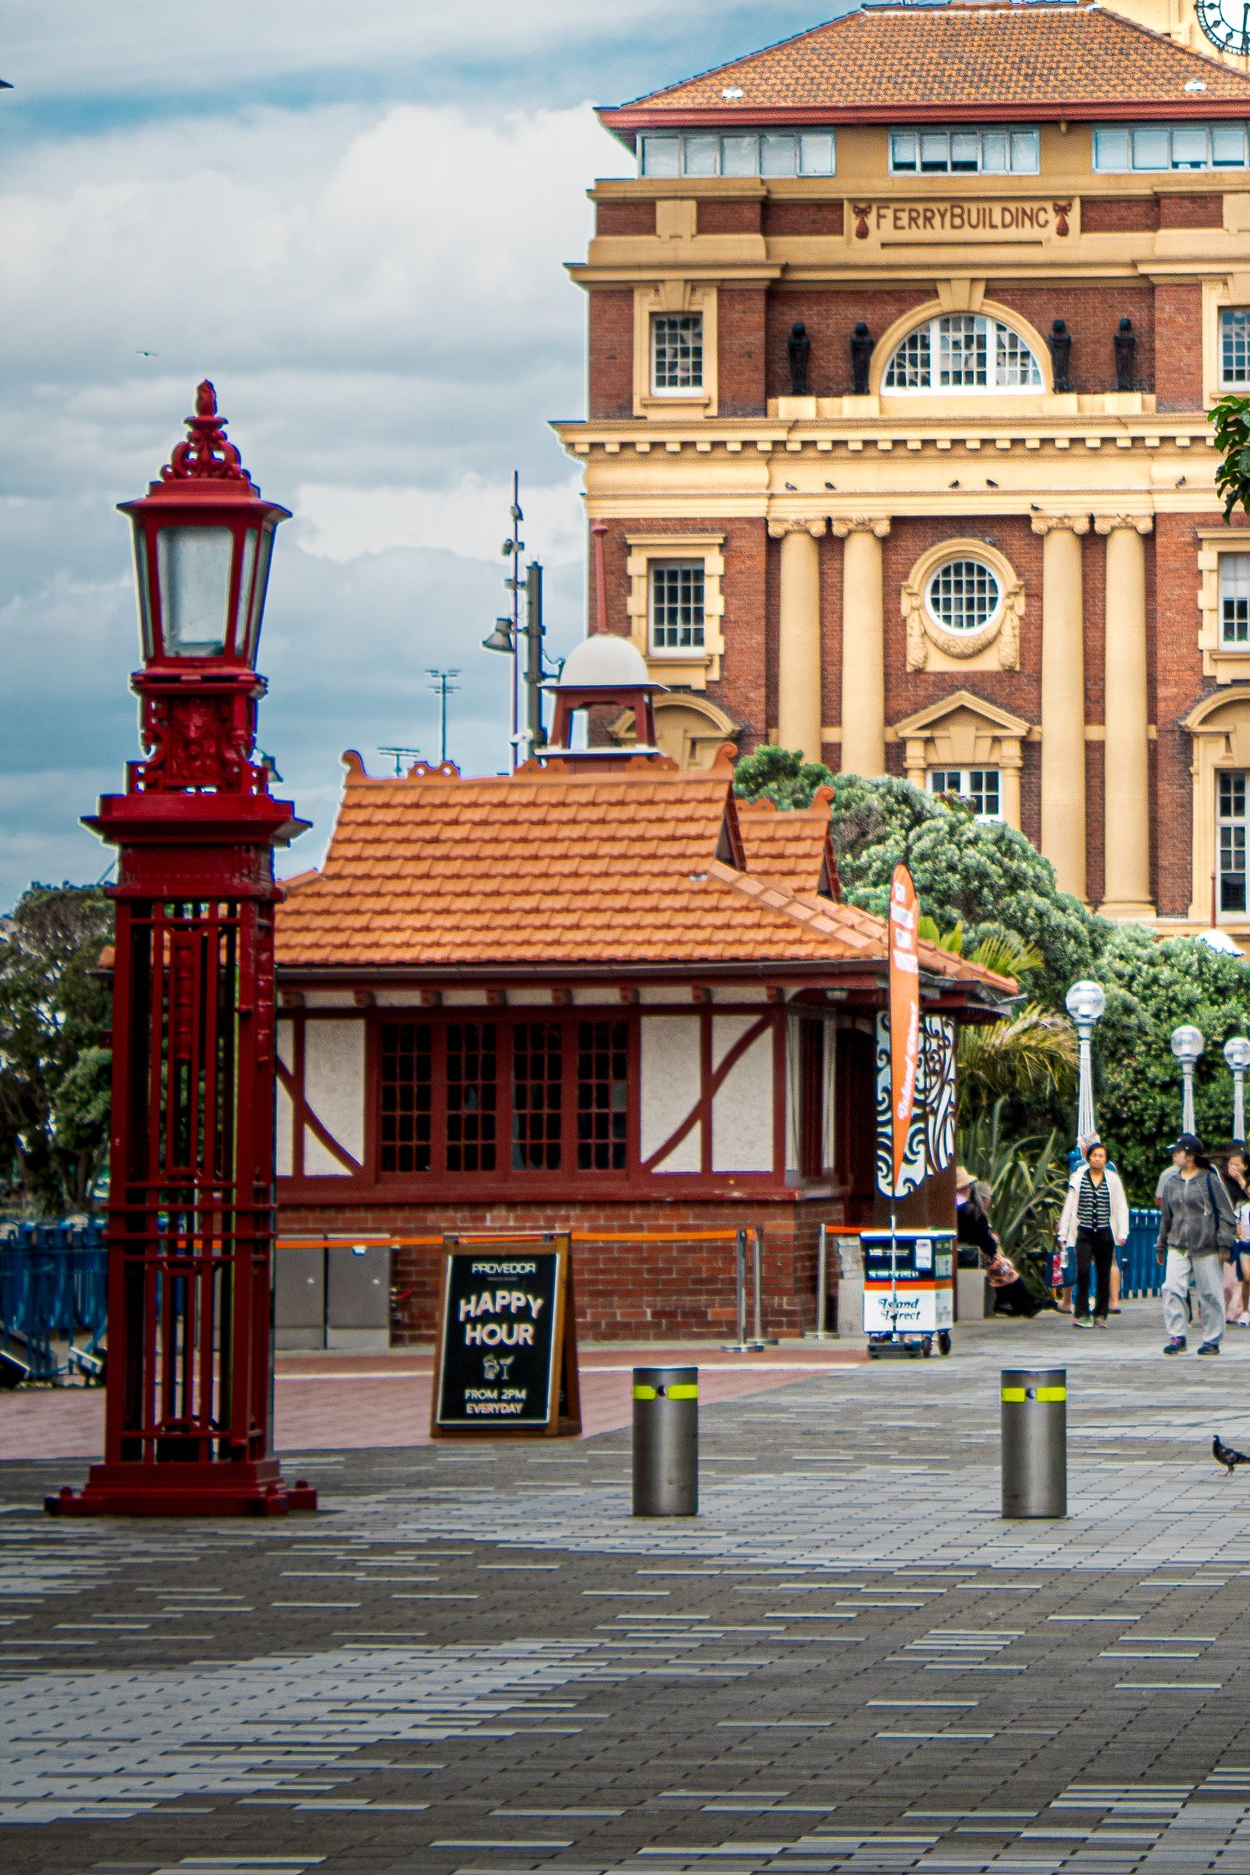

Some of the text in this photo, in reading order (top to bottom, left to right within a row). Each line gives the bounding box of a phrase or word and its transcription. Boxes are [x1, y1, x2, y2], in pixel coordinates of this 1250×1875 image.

[876, 204, 1050, 230] FERRY BUILDING
[471, 1262, 536, 1274] PROVEDOR
[459, 1290, 544, 1322] HAPPY
[465, 1323, 535, 1346] HOUR
[464, 1389, 527, 1400] FROM 2PM
[466, 1403, 523, 1414] EVERYDAY
